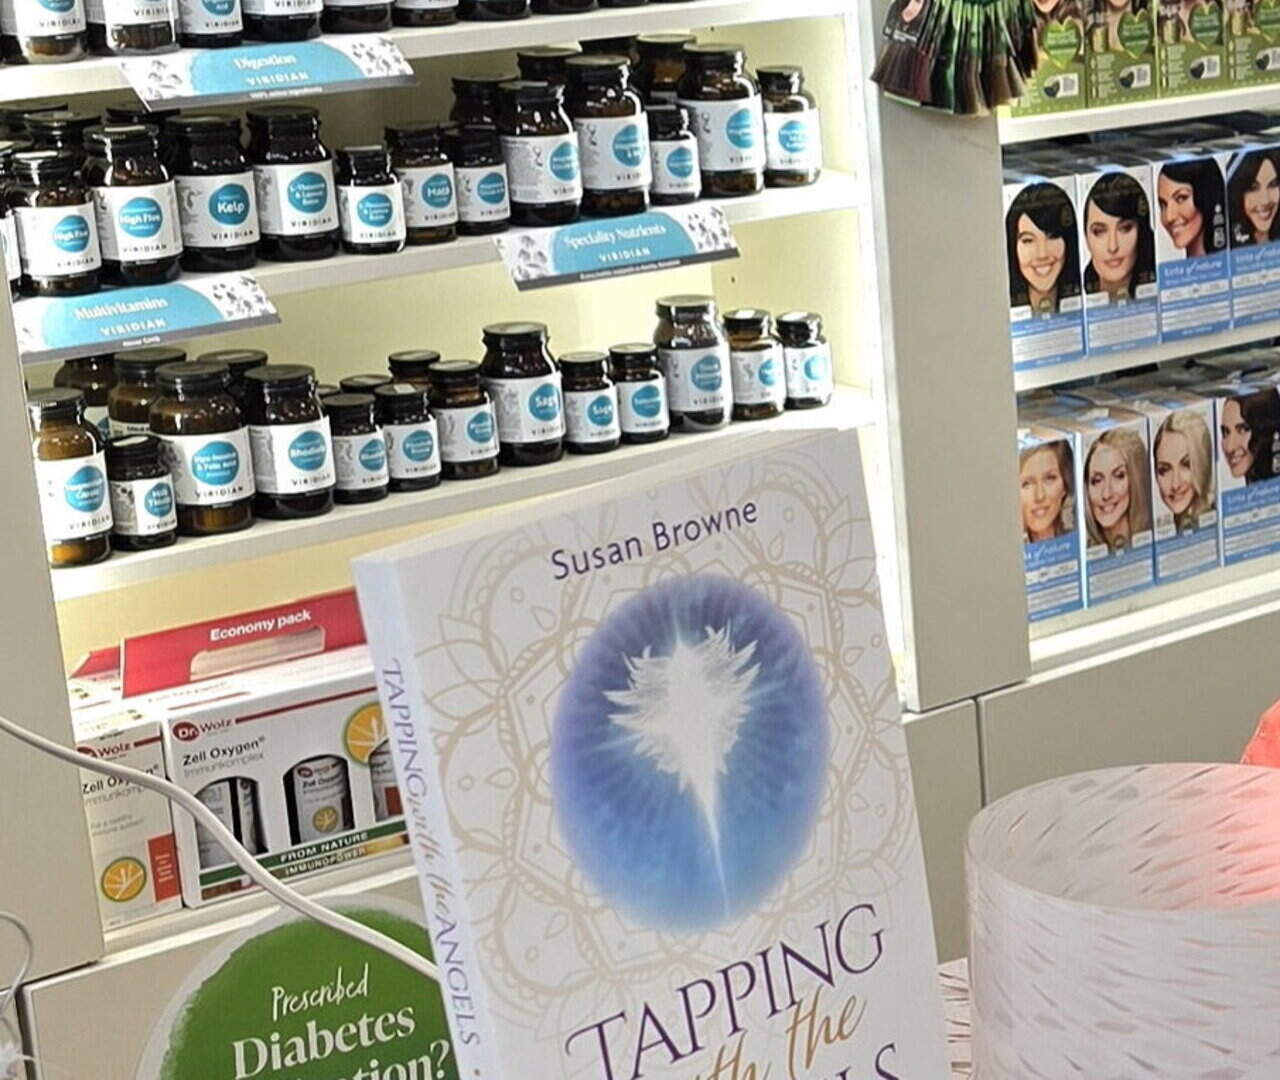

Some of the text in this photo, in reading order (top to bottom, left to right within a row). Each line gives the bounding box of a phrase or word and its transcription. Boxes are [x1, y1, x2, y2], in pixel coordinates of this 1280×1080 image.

[246, 72, 309, 87] VIRIDIAN
[217, 199, 245, 216] Kelp
[101, 319, 166, 337] VIRIDIAN
[552, 500, 760, 581] Susan Browne
[210, 608, 312, 642] Economy pack
[199, 716, 234, 734] Wolz
[98, 741, 131, 758] Wolz
[181, 749, 207, 767] Zell
[81, 779, 105, 796] Zell
[280, 831, 370, 863] FROM NATURE
[381, 658, 427, 794] TAPPING
[432, 914, 481, 1048] ANGELS
[272, 962, 370, 1022] Prescribed
[565, 903, 886, 1080] TAPPING
[233, 1006, 417, 1080] Diabetes
